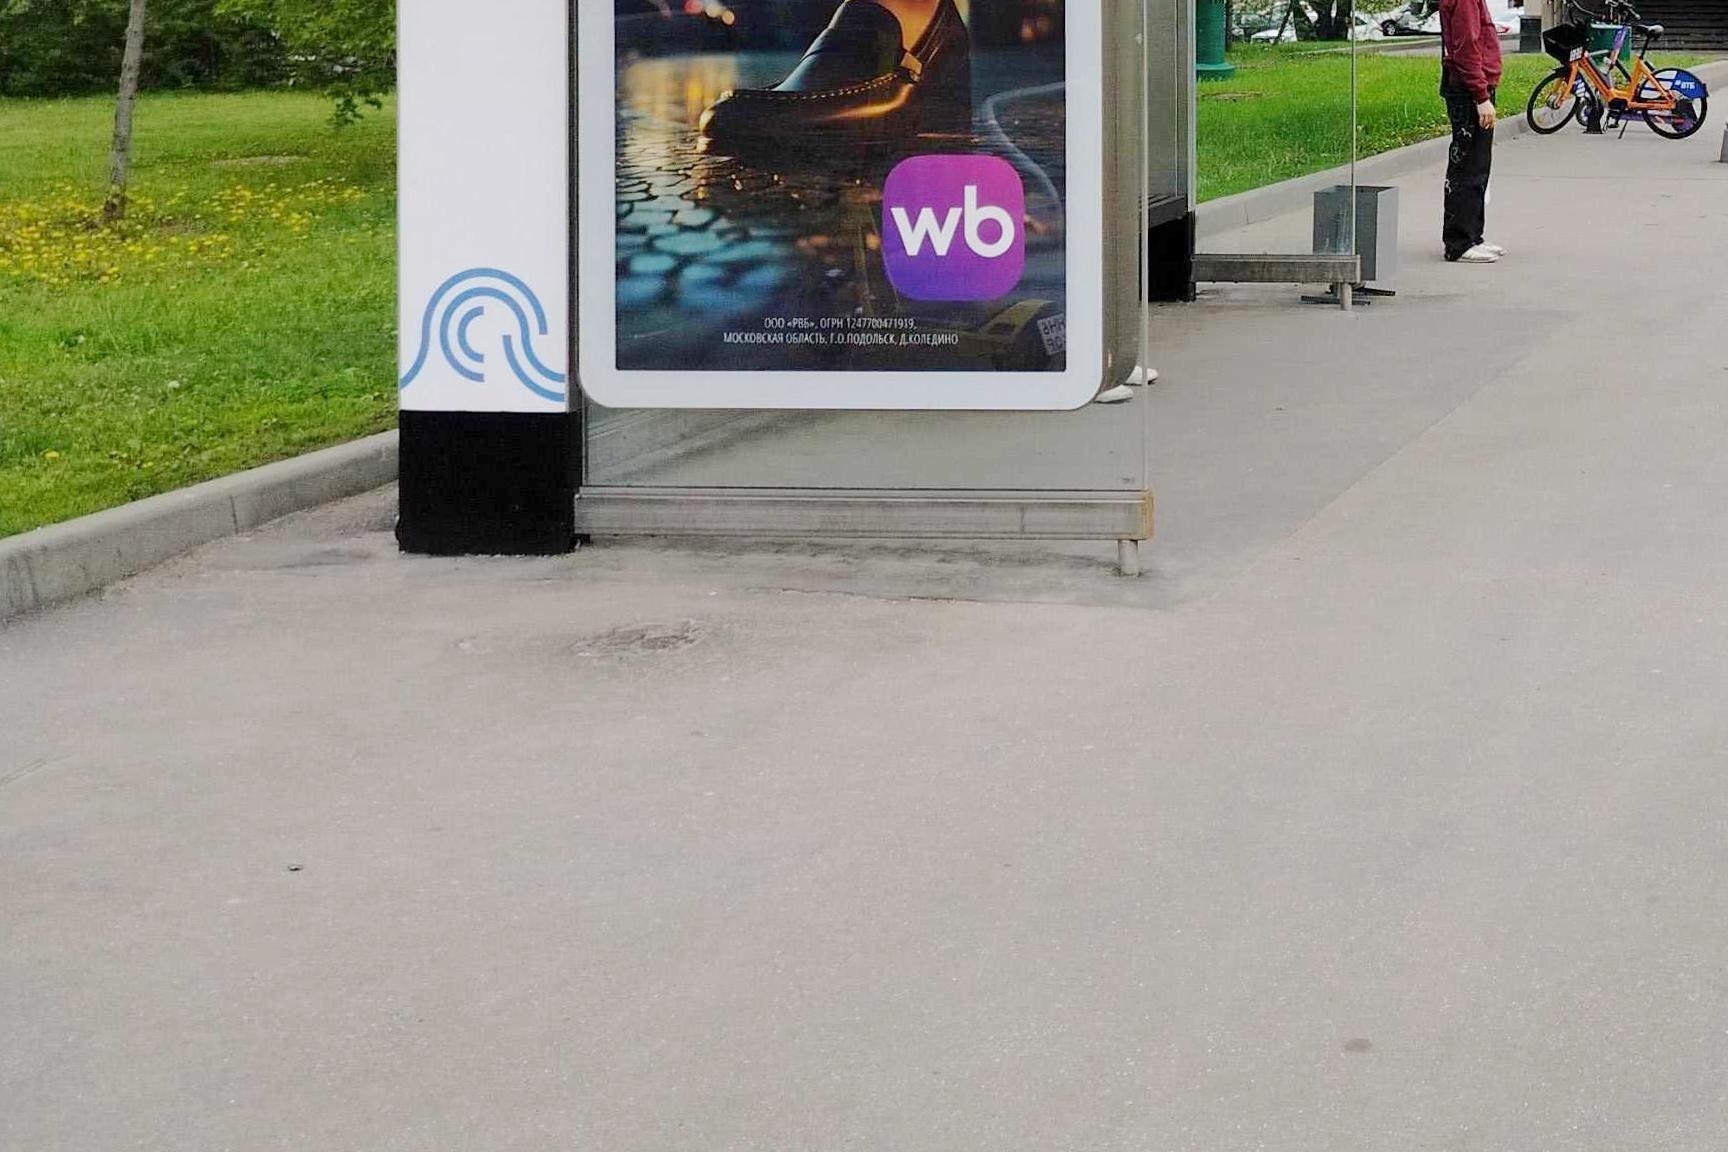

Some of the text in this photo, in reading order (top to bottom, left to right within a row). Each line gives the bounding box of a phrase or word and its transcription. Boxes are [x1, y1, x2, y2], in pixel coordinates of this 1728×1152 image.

[890, 185, 1015, 258] wb
[764, 317, 785, 329] ООО
[820, 317, 844, 329] ОГРН
[723, 333, 784, 344] МОСКОВСКАЯ
